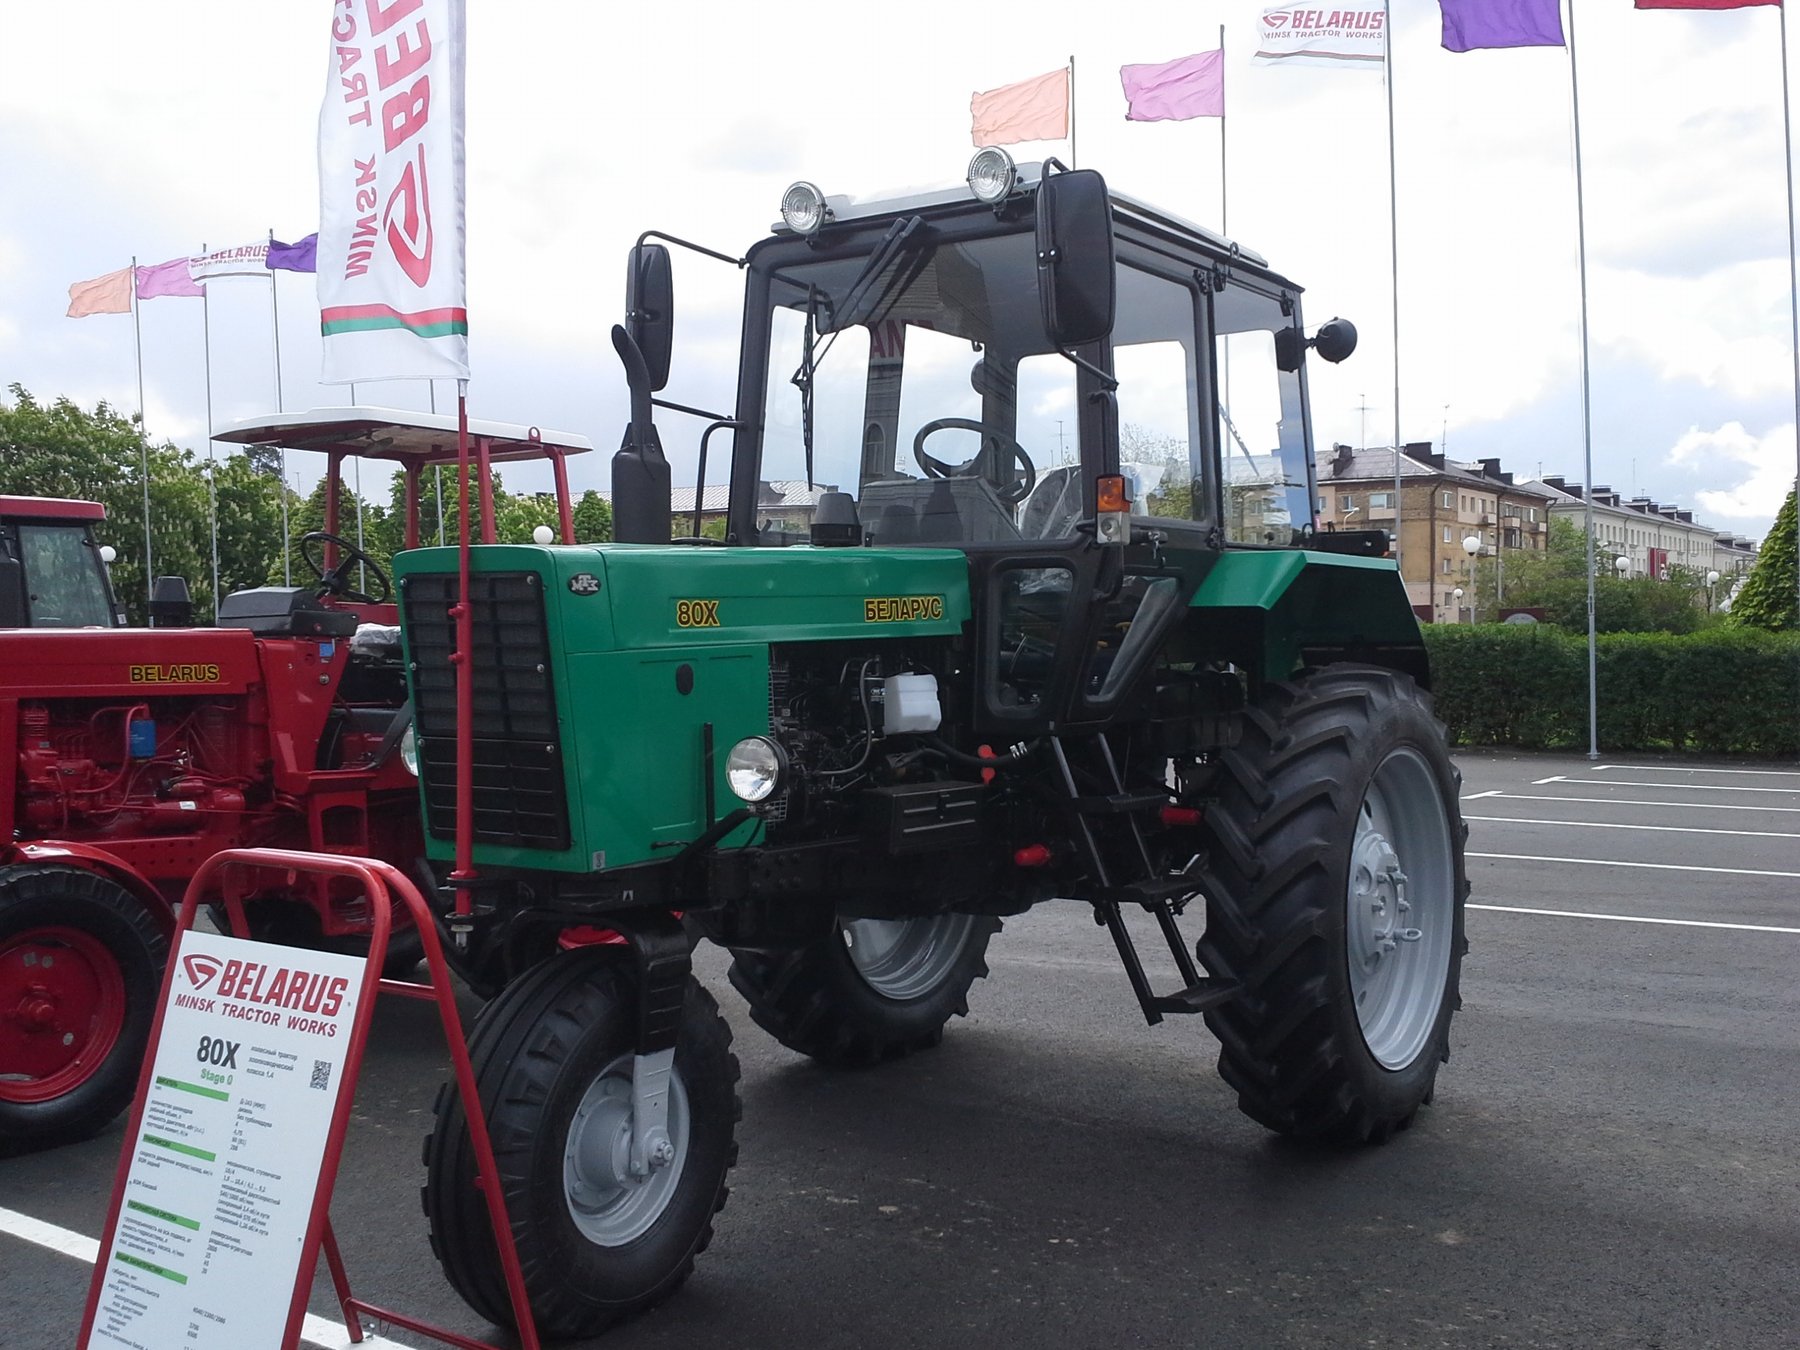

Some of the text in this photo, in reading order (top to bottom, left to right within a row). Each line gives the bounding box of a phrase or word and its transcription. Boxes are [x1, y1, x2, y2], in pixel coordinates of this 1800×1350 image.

[1292, 10, 1385, 29] BELARUS
[1295, 29, 1340, 39] TRACTOR
[1345, 31, 1383, 39] WORKS
[864, 597, 942, 622] БЕЛАРУС
[130, 664, 220, 683] BELARUS
[217, 959, 349, 1017] BELARUS
[175, 994, 338, 1037] MINSK TRACTOR WORKS
[197, 1035, 241, 1069] 80X
[201, 1068, 225, 1085] Stage
